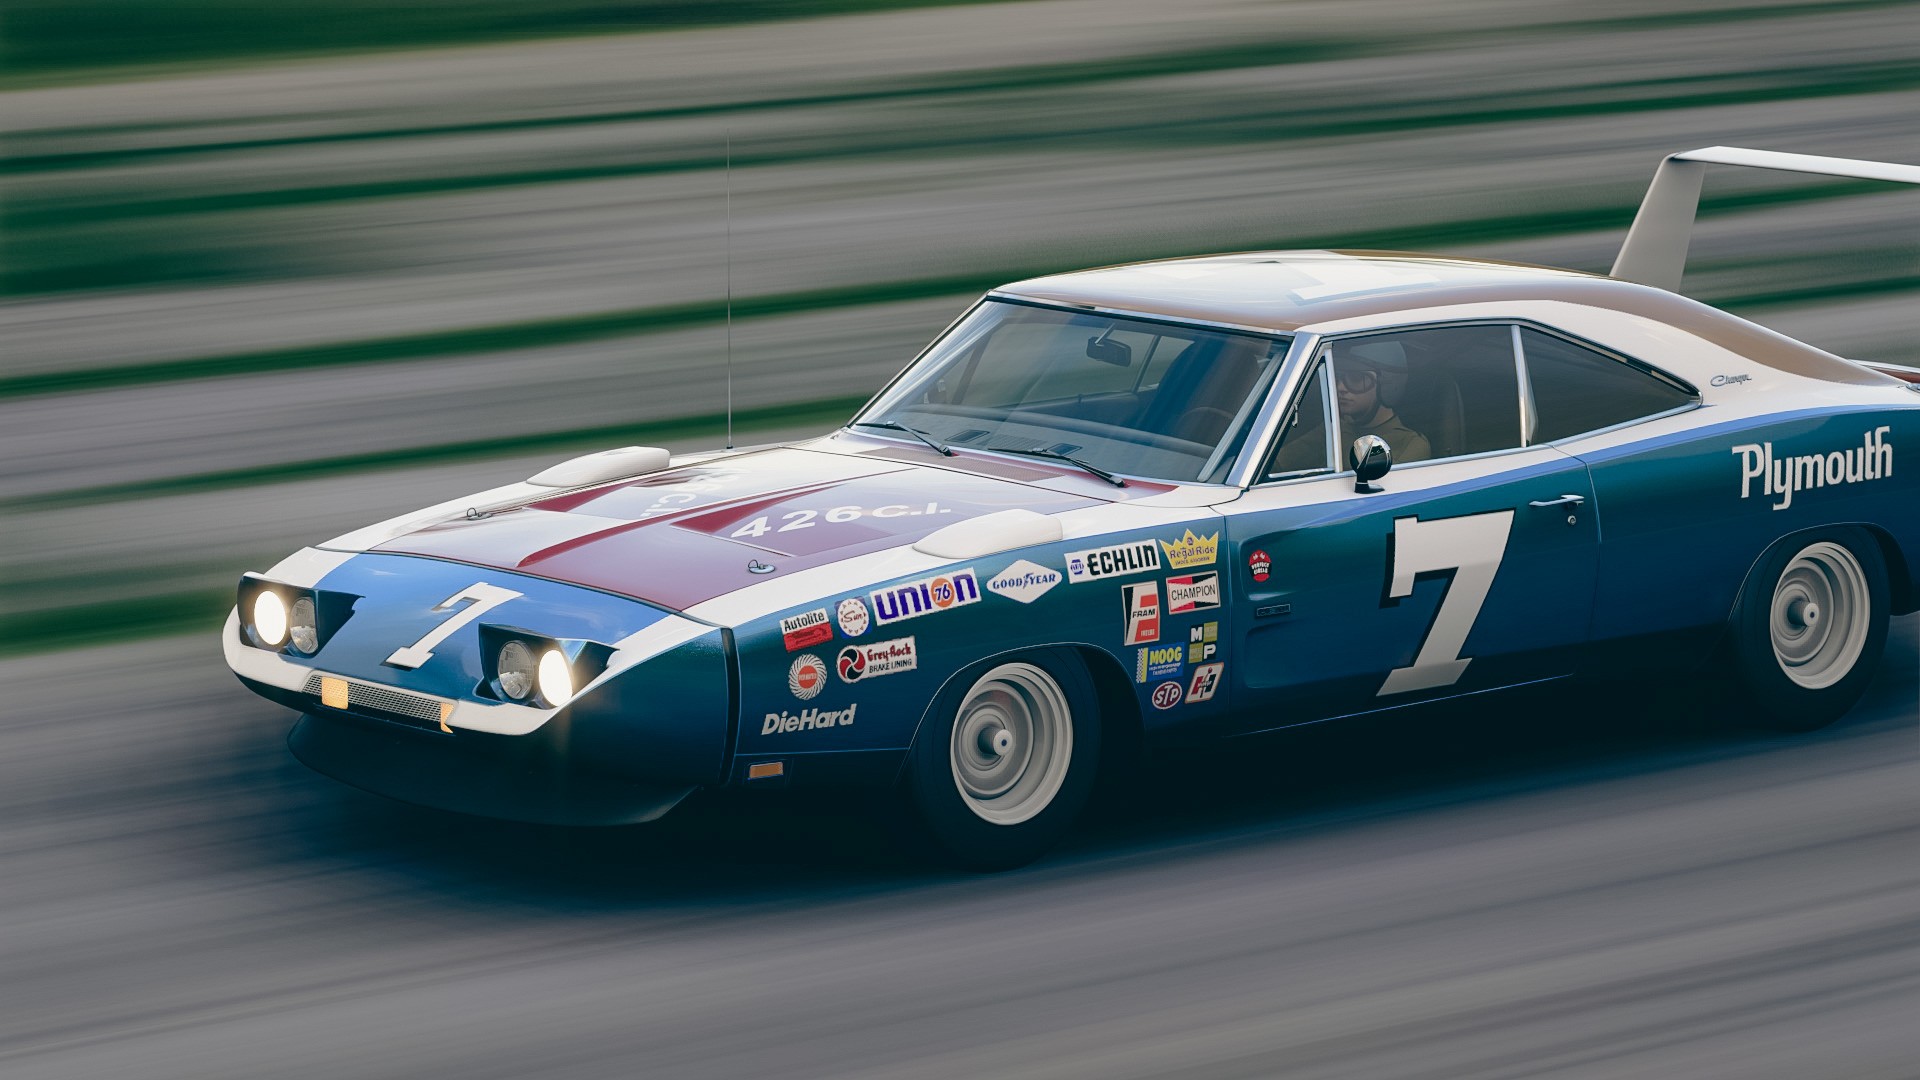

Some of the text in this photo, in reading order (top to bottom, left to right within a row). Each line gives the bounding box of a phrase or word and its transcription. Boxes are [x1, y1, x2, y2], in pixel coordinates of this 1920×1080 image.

[1731, 425, 1893, 511] Plymouth
[1087, 544, 1157, 576] ECHLIN
[1171, 584, 1216, 601] CHAMPION
[1375, 509, 1515, 697] 7
[784, 612, 825, 632] Autolite
[1132, 608, 1156, 618] FRAM
[384, 581, 525, 669] 7
[869, 658, 912, 674] BRAKE LINING
[1149, 646, 1183, 666] MOOG
[1155, 685, 1179, 706] STP
[761, 703, 857, 736] DieHard
